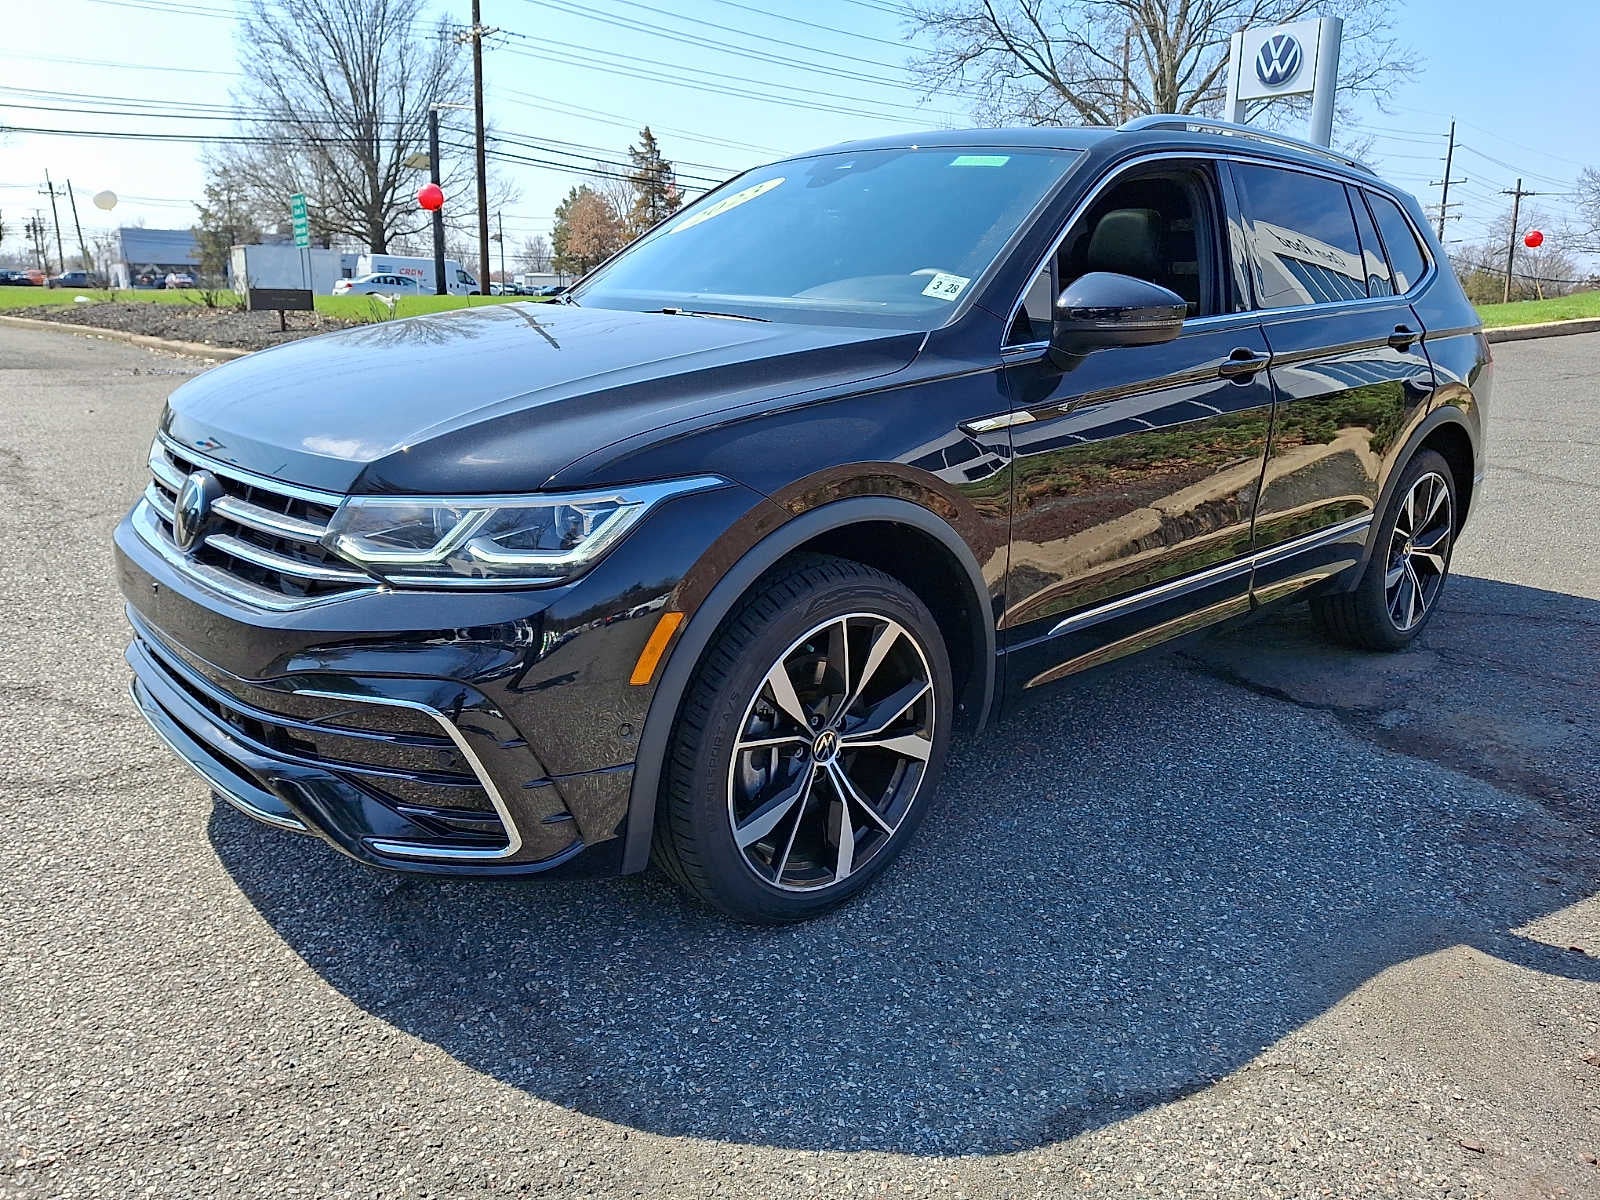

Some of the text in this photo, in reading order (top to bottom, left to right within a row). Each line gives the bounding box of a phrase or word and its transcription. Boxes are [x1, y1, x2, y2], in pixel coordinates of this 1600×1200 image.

[1256, 33, 1302, 87] VW
[932, 280, 960, 294] 3 28
